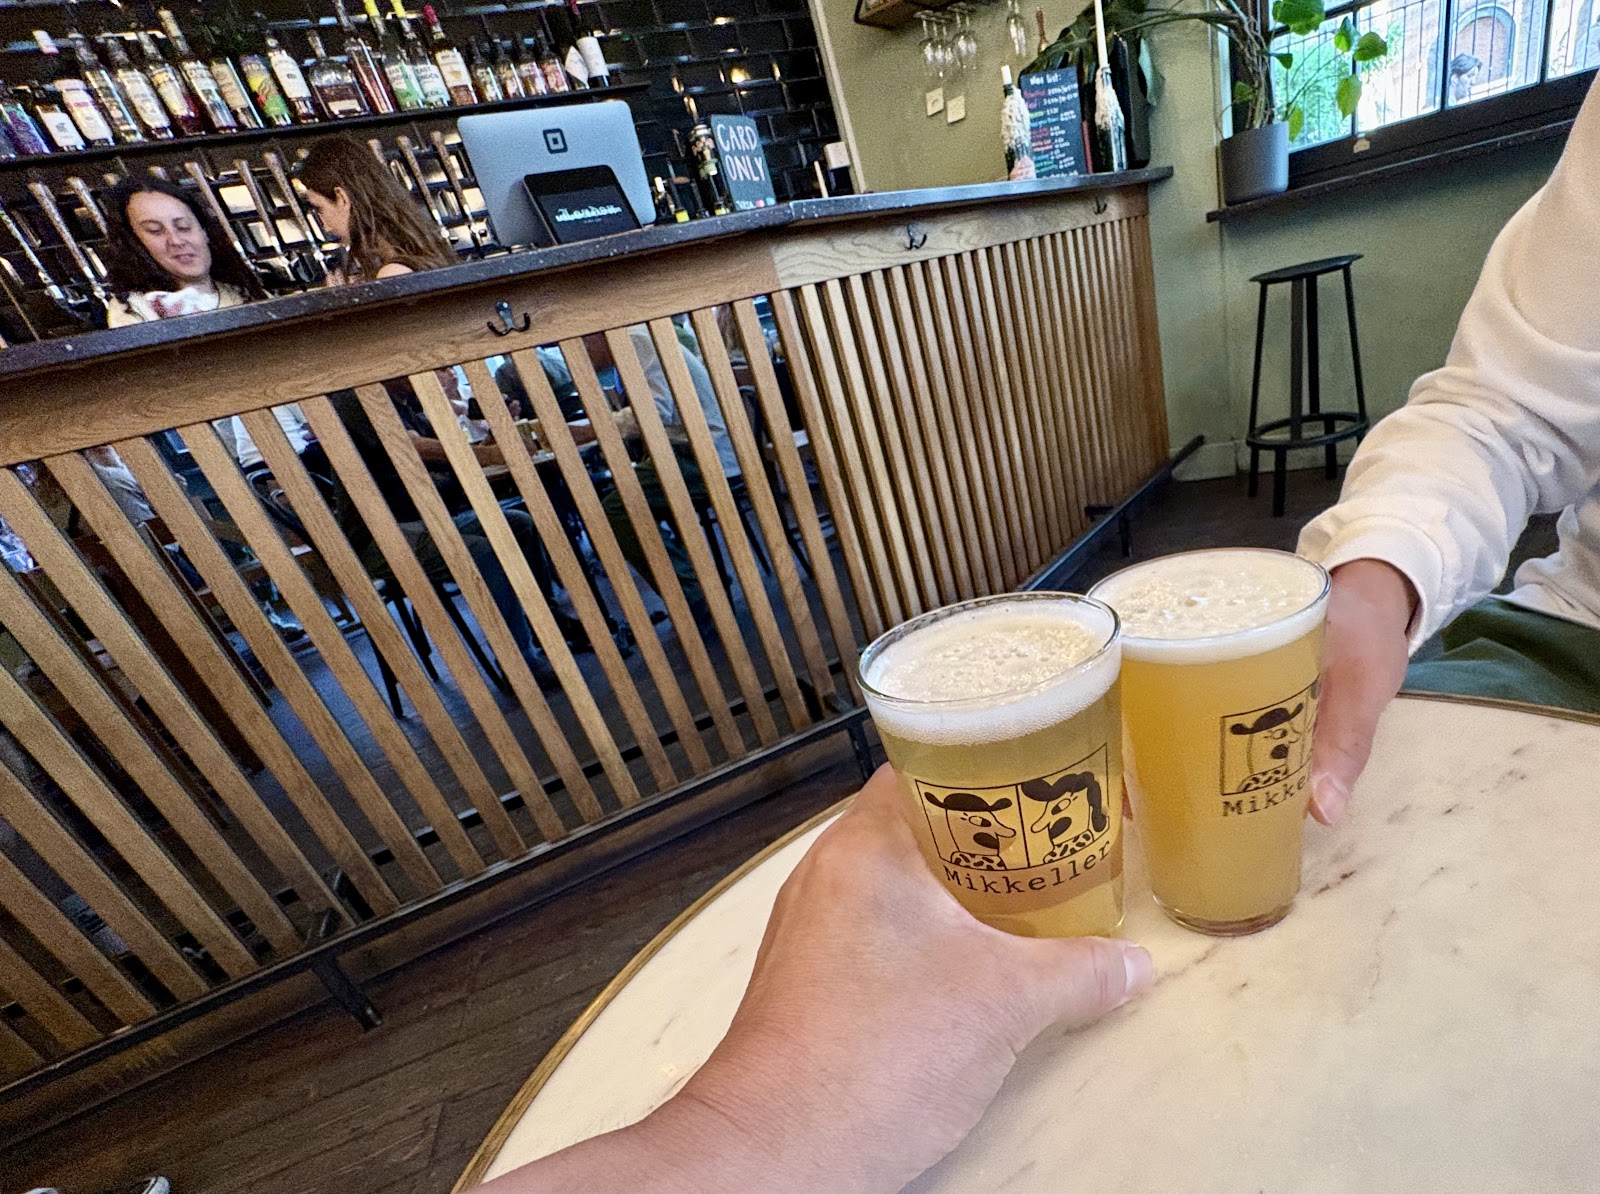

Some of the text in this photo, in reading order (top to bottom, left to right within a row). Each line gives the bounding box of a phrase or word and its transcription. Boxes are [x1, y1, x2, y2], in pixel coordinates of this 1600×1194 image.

[716, 123, 757, 152] CARD
[725, 154, 766, 181] ONLY
[943, 840, 1110, 894] Mikkeller
